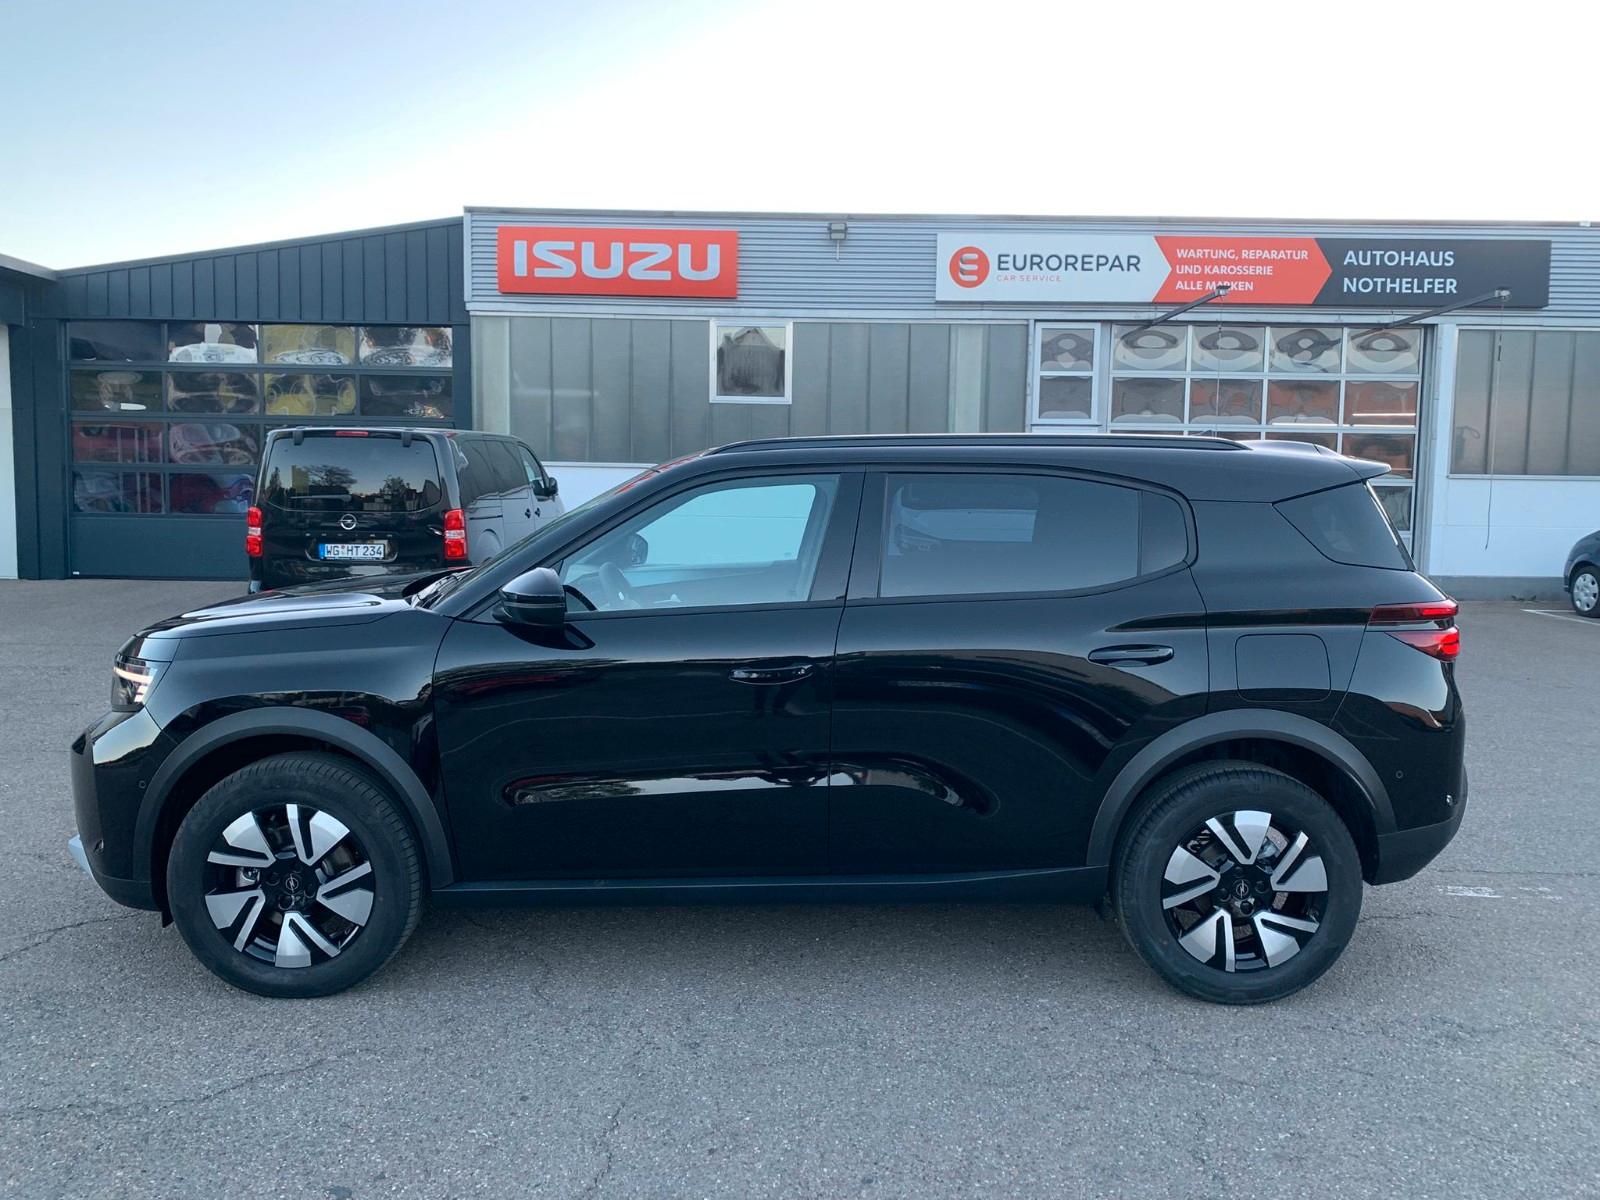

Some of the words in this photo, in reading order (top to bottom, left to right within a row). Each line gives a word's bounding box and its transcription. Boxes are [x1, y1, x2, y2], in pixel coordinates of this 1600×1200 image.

[513, 239, 721, 281] ISUZU
[1176, 248, 1239, 260] WARTUNG,
[1241, 249, 1309, 260] REPARATUR
[1343, 250, 1455, 266] AUTOHAUS
[997, 254, 1141, 272] EUROREPAR
[1176, 264, 1202, 275] UND
[1204, 265, 1273, 276] KAROSSERIE
[1175, 280, 1203, 290] ALLE
[1343, 277, 1458, 294] NOTHELFER
[346, 545, 361, 556] HT
[362, 545, 383, 556] 234
